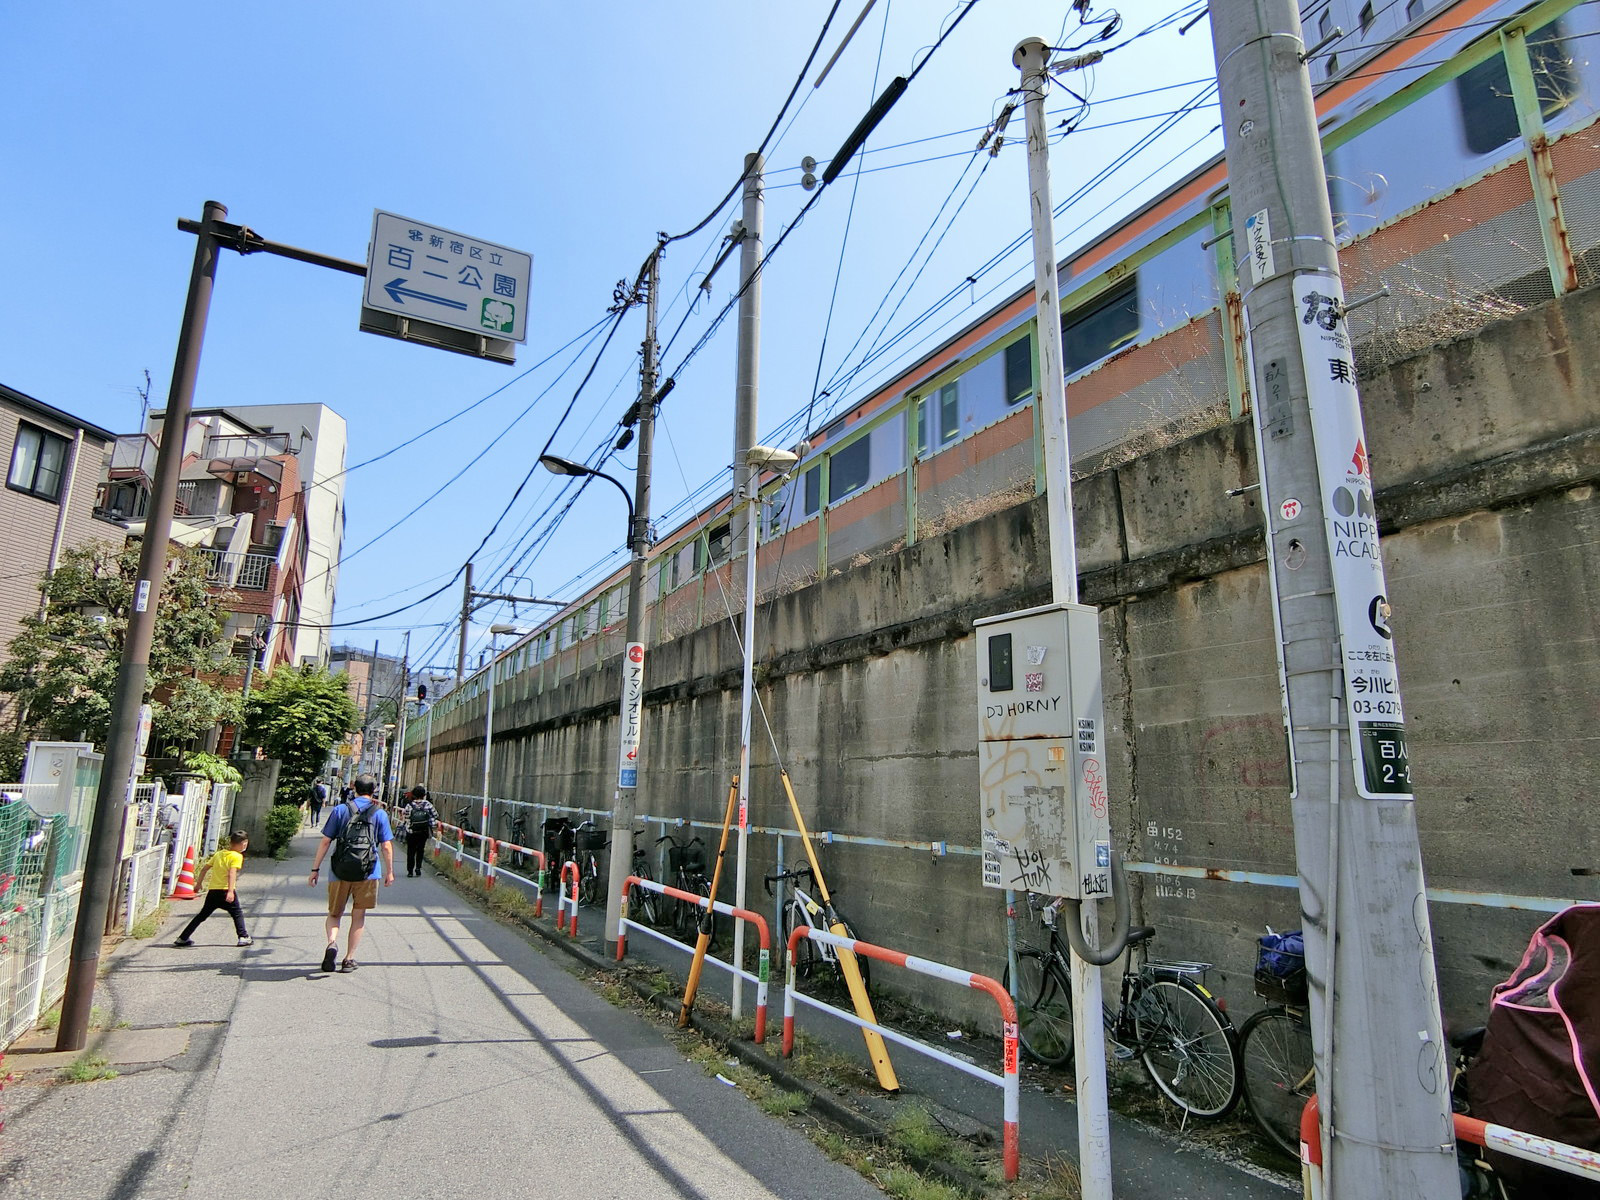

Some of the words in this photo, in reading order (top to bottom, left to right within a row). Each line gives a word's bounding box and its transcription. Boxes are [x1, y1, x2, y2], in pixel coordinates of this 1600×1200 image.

[429, 233, 504, 266] 新宿区立
[388, 243, 517, 298] 百二公園
[1333, 520, 1378, 540] NIPP
[138, 581, 149, 610] 新宿区
[626, 667, 641, 737] アマシオビル
[986, 705, 1004, 719] DJ
[1007, 696, 1062, 716] HORNY
[1077, 719, 1095, 730] KSINO
[1078, 730, 1095, 741] KSINO
[1079, 741, 1096, 752] KSINO
[1162, 827, 1183, 840] 152
[984, 863, 1001, 873] KSINO
[984, 874, 1001, 885] KSINO
